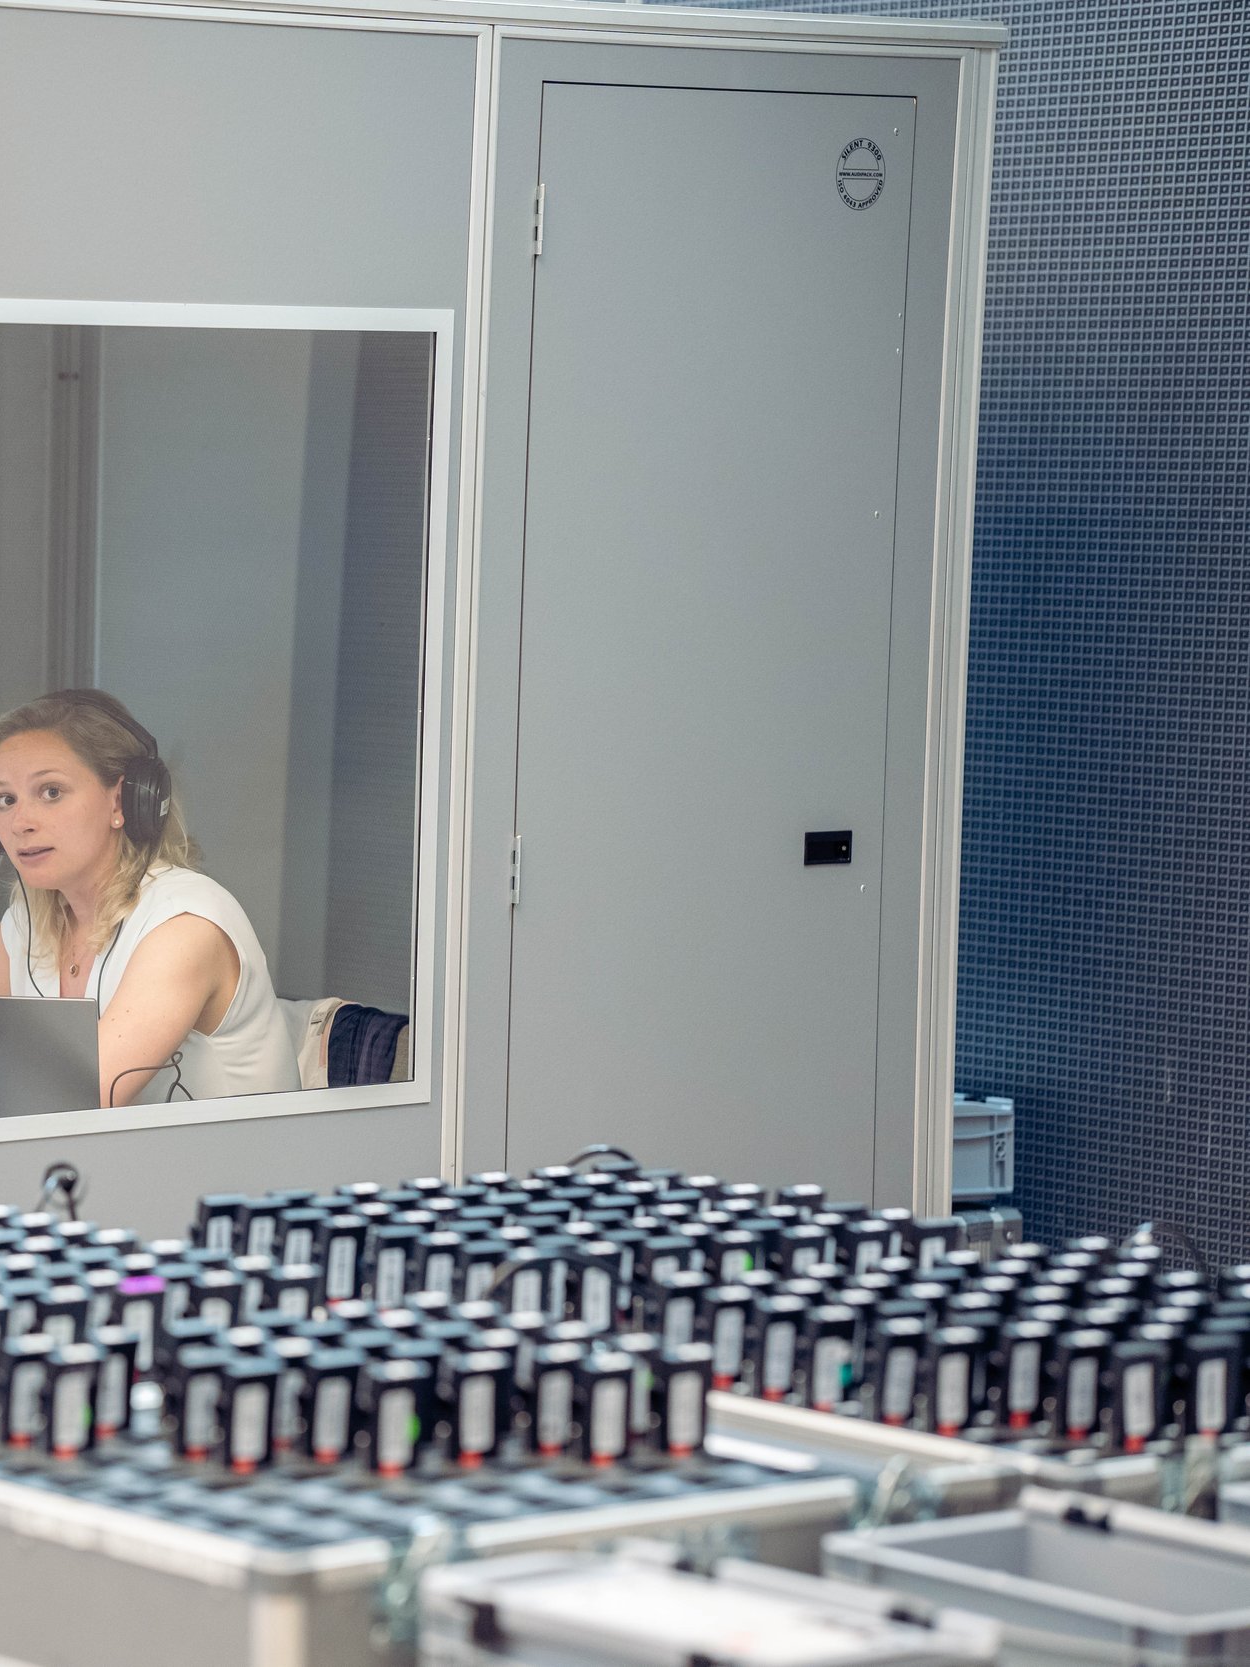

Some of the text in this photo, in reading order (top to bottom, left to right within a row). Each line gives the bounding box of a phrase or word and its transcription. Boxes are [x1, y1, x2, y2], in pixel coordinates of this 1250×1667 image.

[842, 140, 882, 161] SILENT 9300
[857, 180, 883, 209] APPROVED
